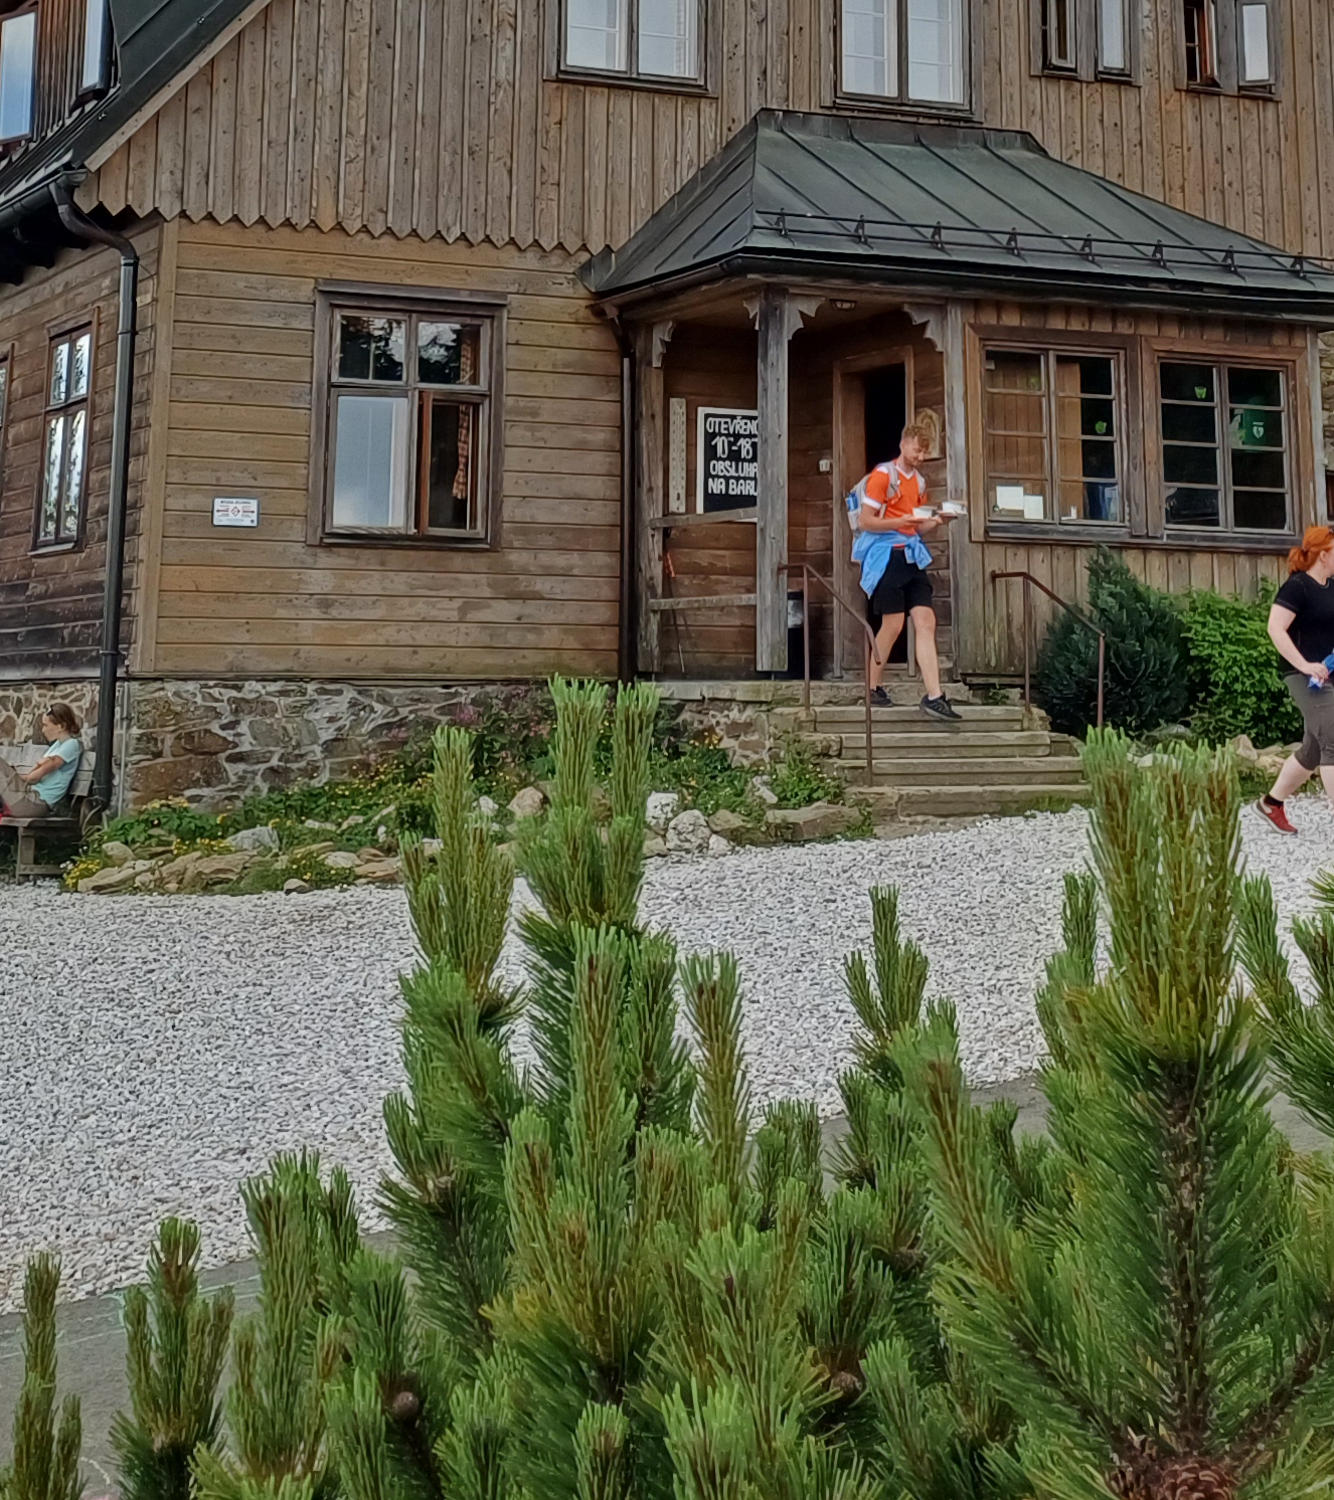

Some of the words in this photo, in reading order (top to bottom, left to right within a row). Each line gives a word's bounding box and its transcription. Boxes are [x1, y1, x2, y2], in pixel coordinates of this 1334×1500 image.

[709, 460, 758, 478] OBSLUHA
[708, 478, 726, 495] NA
[728, 479, 758, 496] BARU
